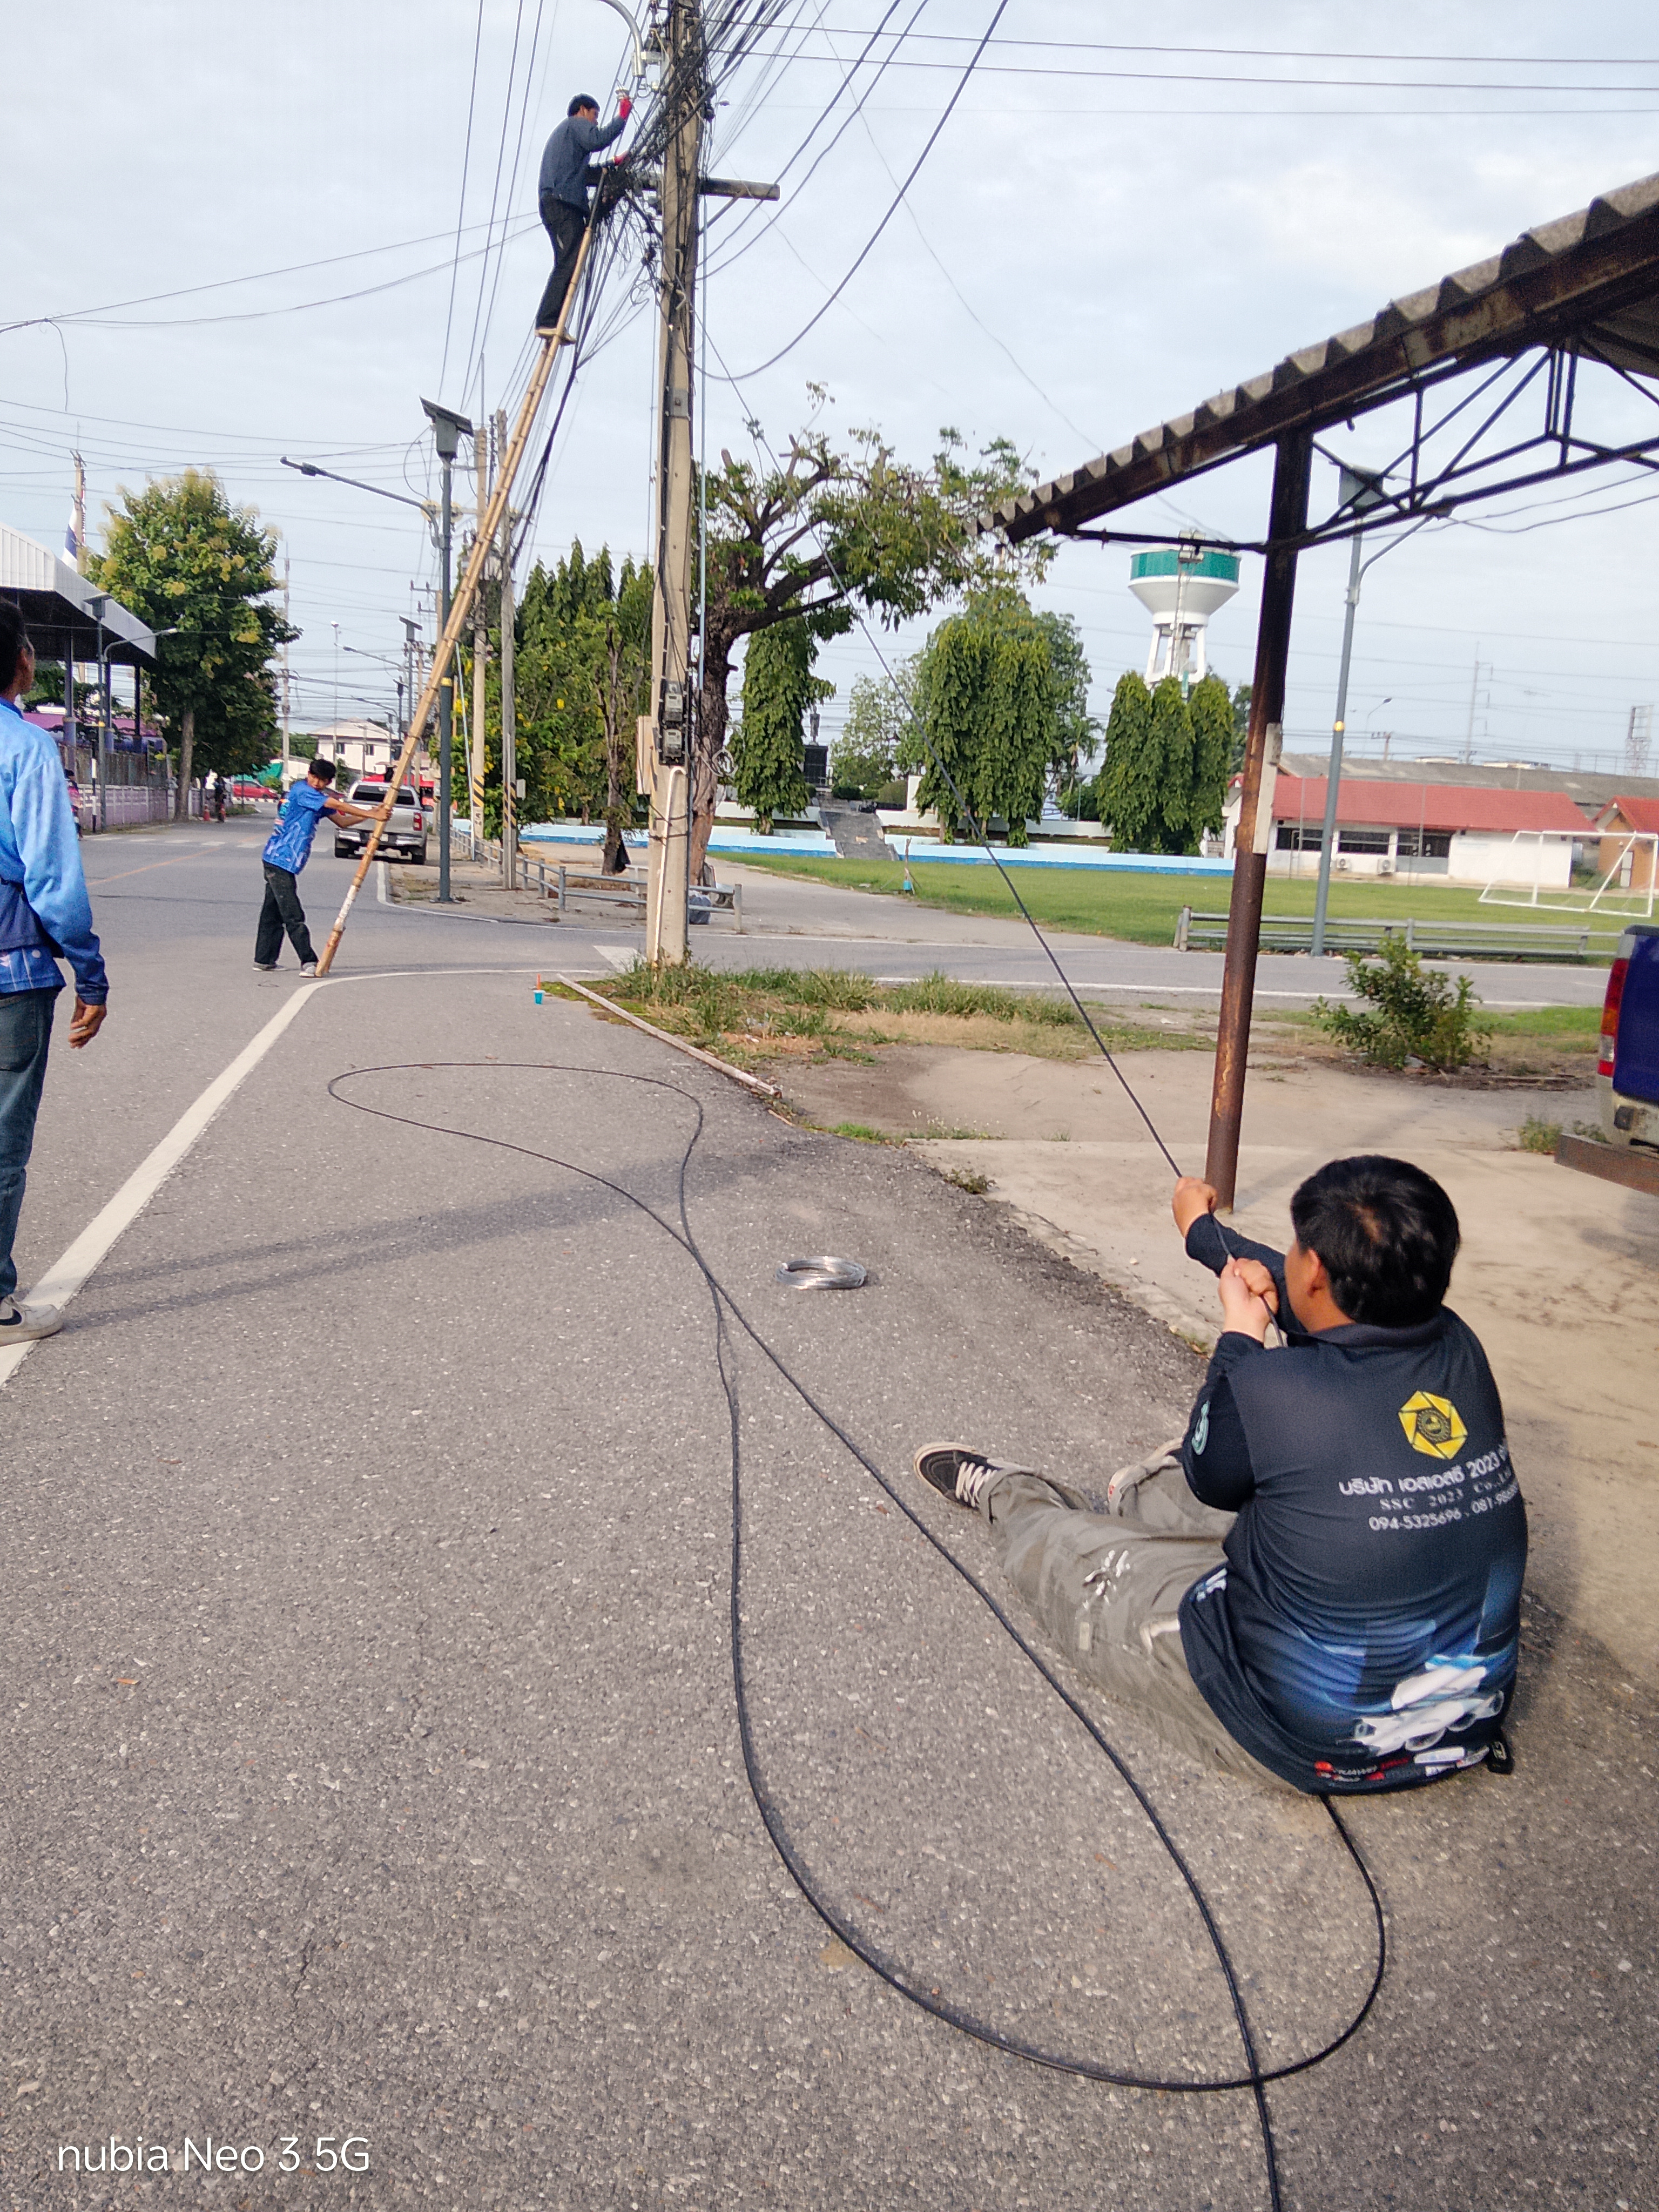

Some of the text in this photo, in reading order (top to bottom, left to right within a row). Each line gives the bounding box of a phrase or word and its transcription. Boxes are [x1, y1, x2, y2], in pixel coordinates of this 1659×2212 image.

[1466, 1451, 1500, 1479] 2023
[1379, 1497, 1415, 1510] SSC
[1428, 1488, 1464, 1507] 2023
